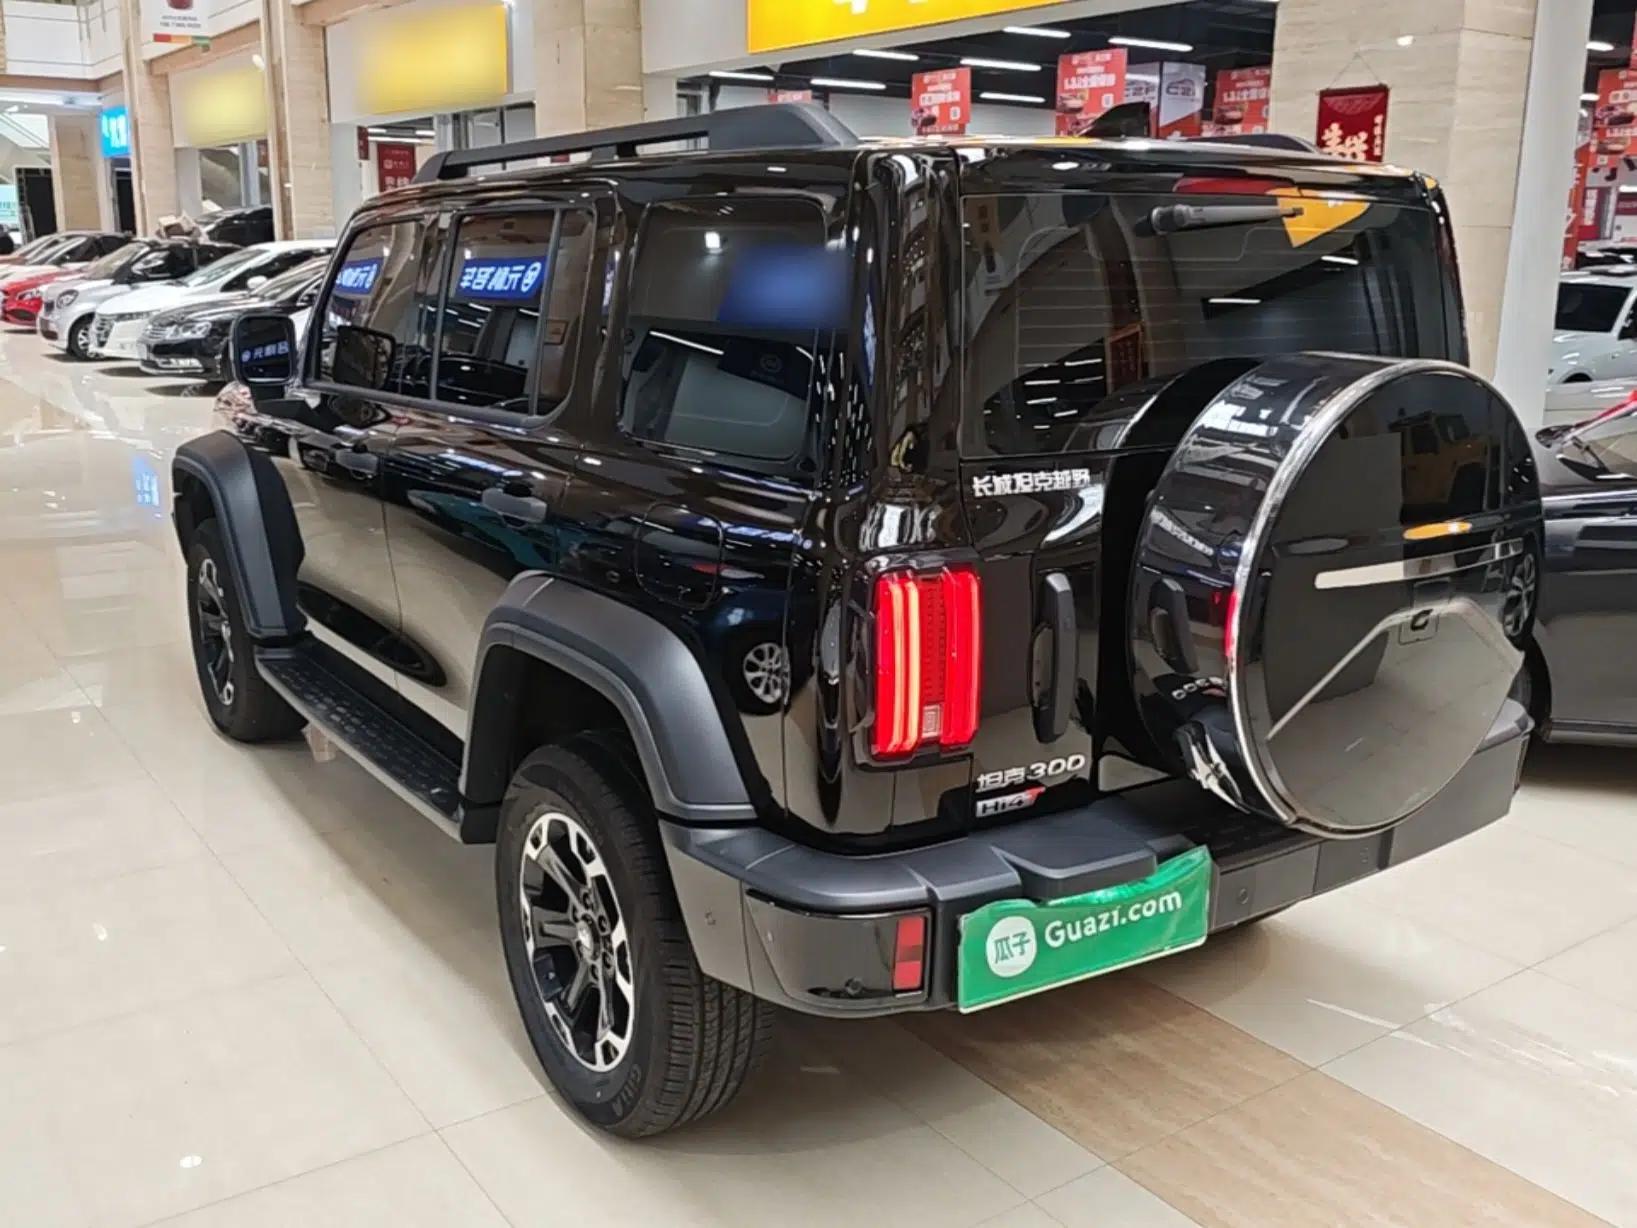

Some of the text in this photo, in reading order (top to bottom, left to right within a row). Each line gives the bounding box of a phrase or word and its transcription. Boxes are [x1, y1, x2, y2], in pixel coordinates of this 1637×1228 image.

[972, 468, 1091, 497] 长城坦克越野
[976, 754, 1086, 790] 坦克300
[994, 889, 1183, 964] 瓜子 Guazi.com
